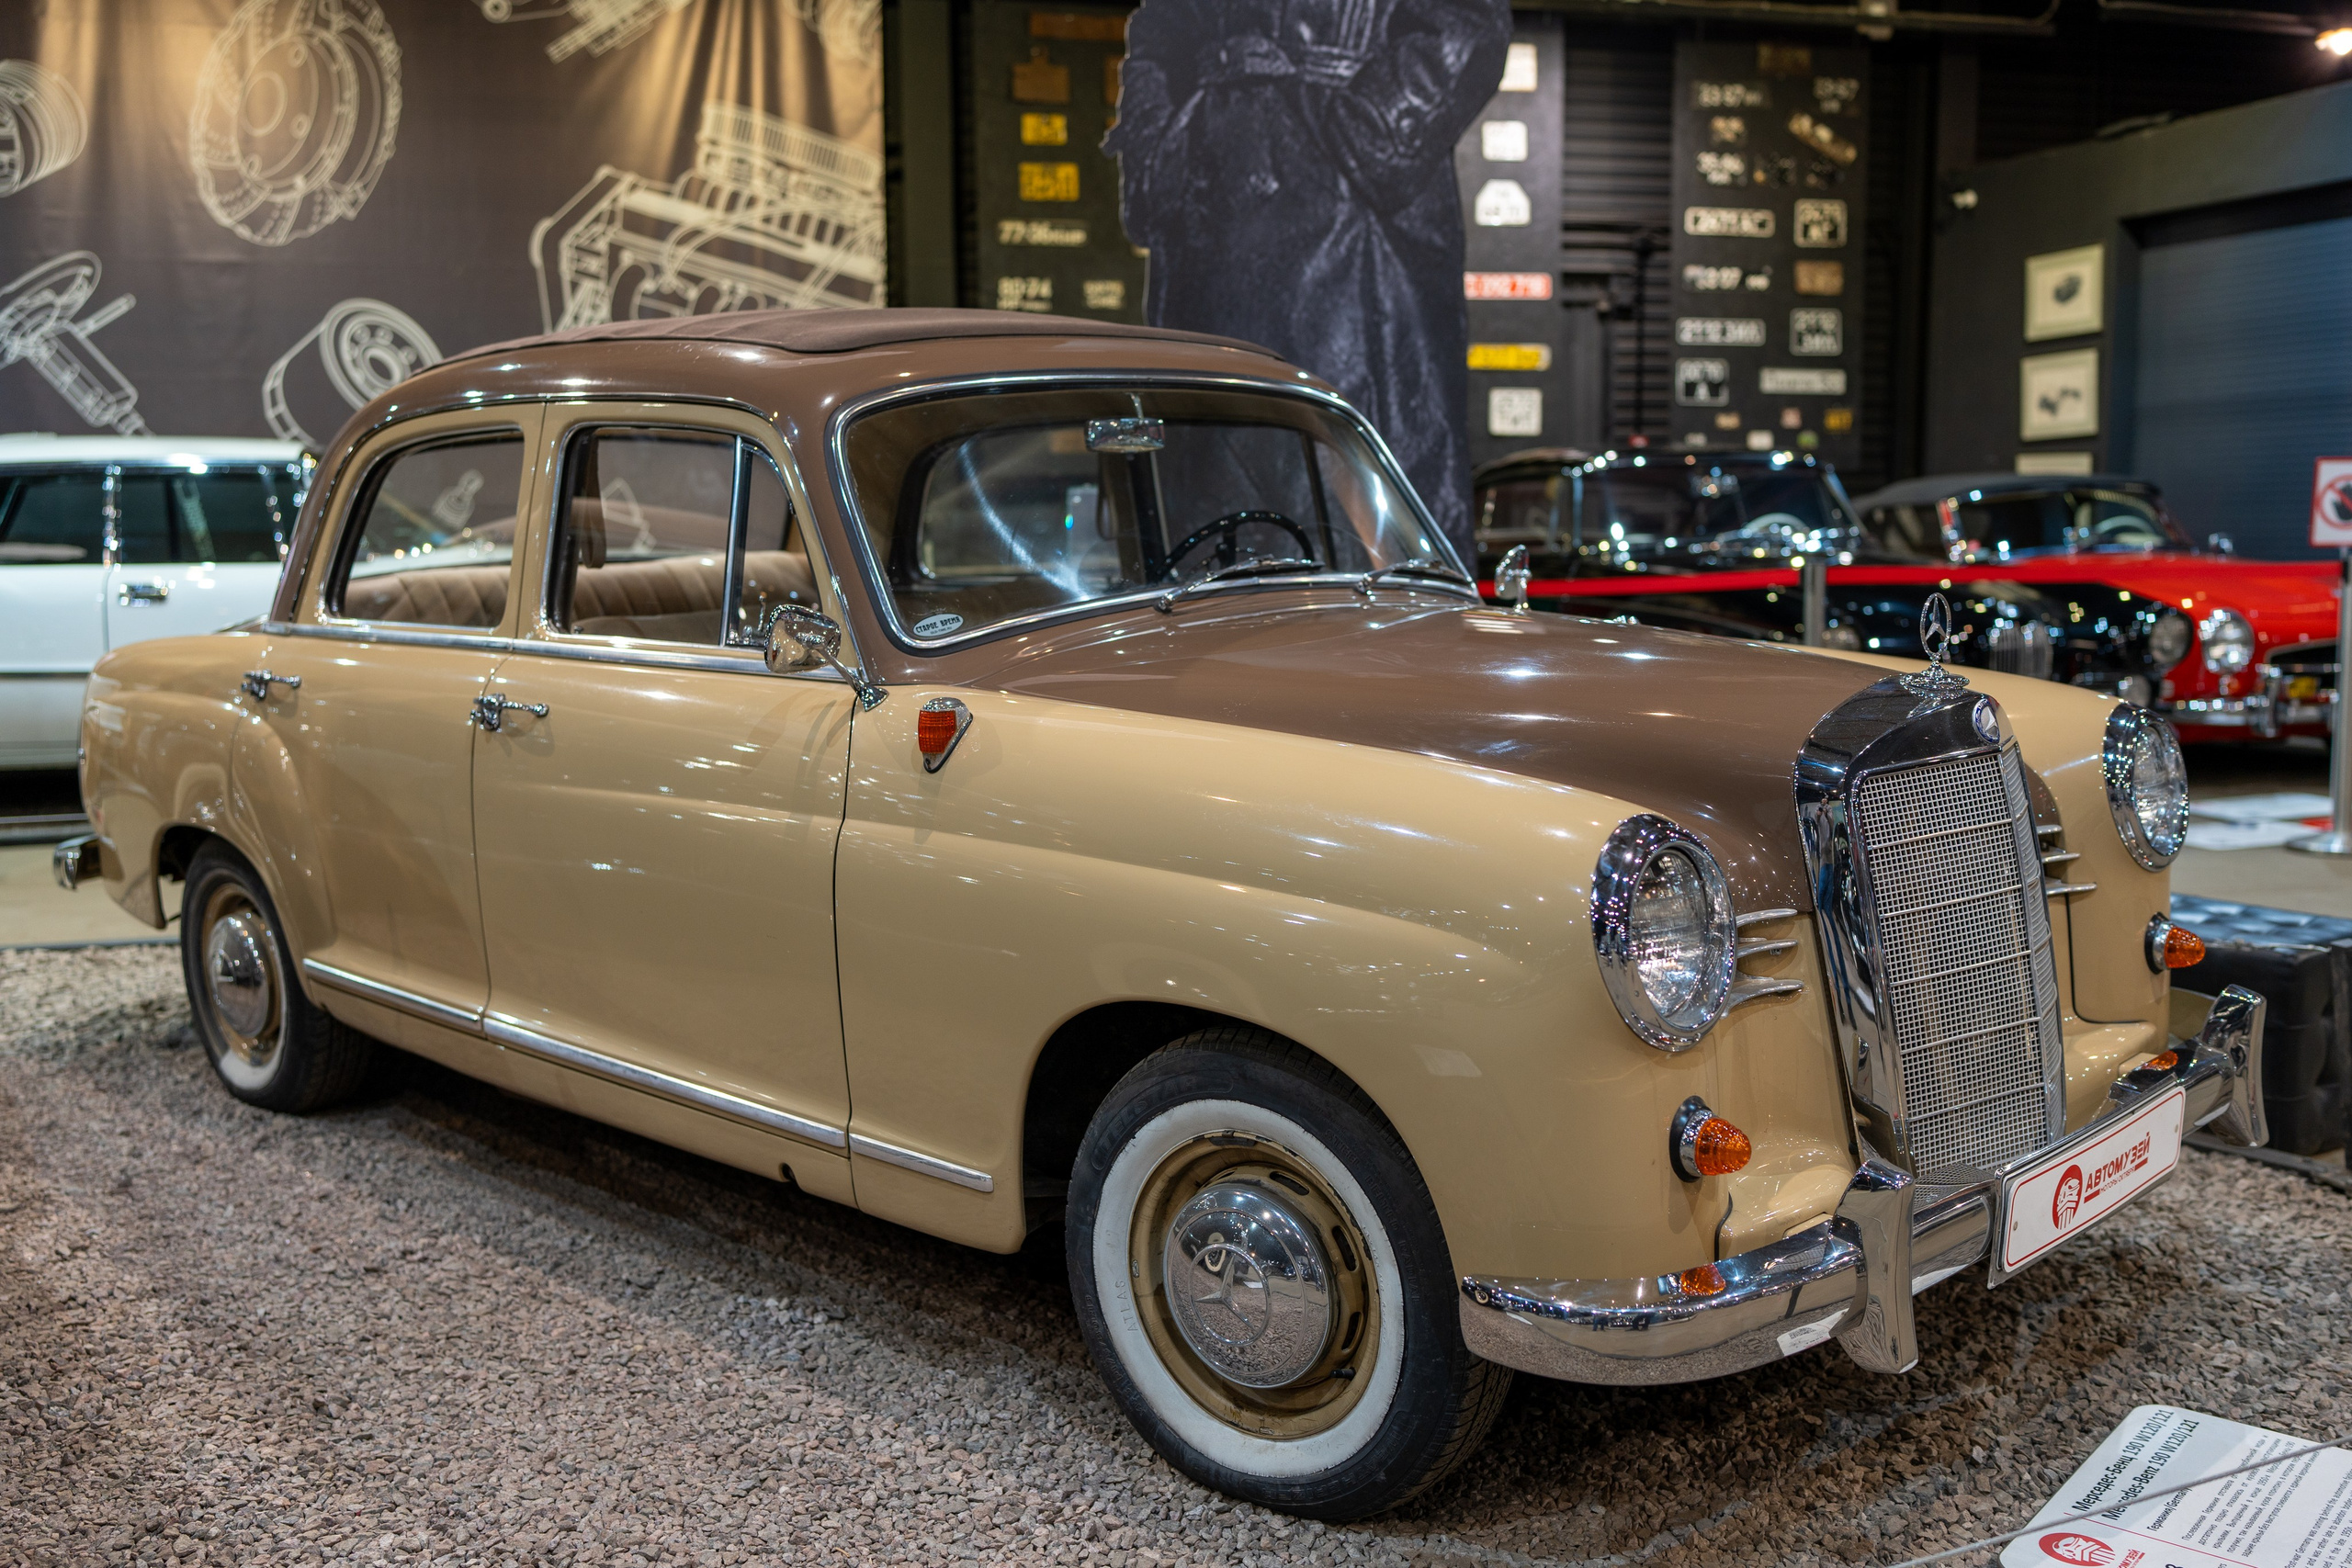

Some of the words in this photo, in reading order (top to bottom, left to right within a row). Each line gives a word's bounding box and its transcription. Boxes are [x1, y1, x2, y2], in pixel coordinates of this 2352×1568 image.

[915, 622, 938, 633] СТАРОЕ
[940, 616, 961, 626] ВРЕМЯ
[1324, 1129, 1362, 1170] STEEL
[2086, 1132, 2150, 1192] АВТОМУЗЕЙ
[2100, 1178, 2118, 1192] МОТОРЫ
[2118, 1166, 2135, 1186] ОКТЯБРЯ
[1114, 1280, 1138, 1332] ATLAS
[2133, 1409, 2174, 1442] W120/121
[2158, 1419, 2199, 1453] W120/121
[2122, 1441, 2145, 1456] 190
[2148, 1452, 2170, 1467] 190
[2072, 1455, 2138, 1512] Мерседес-Бенц
[2147, 1487, 2192, 1531] Германия/Germany
[2202, 1497, 2220, 1514] Германия
[2215, 1509, 2229, 1522] поздно
